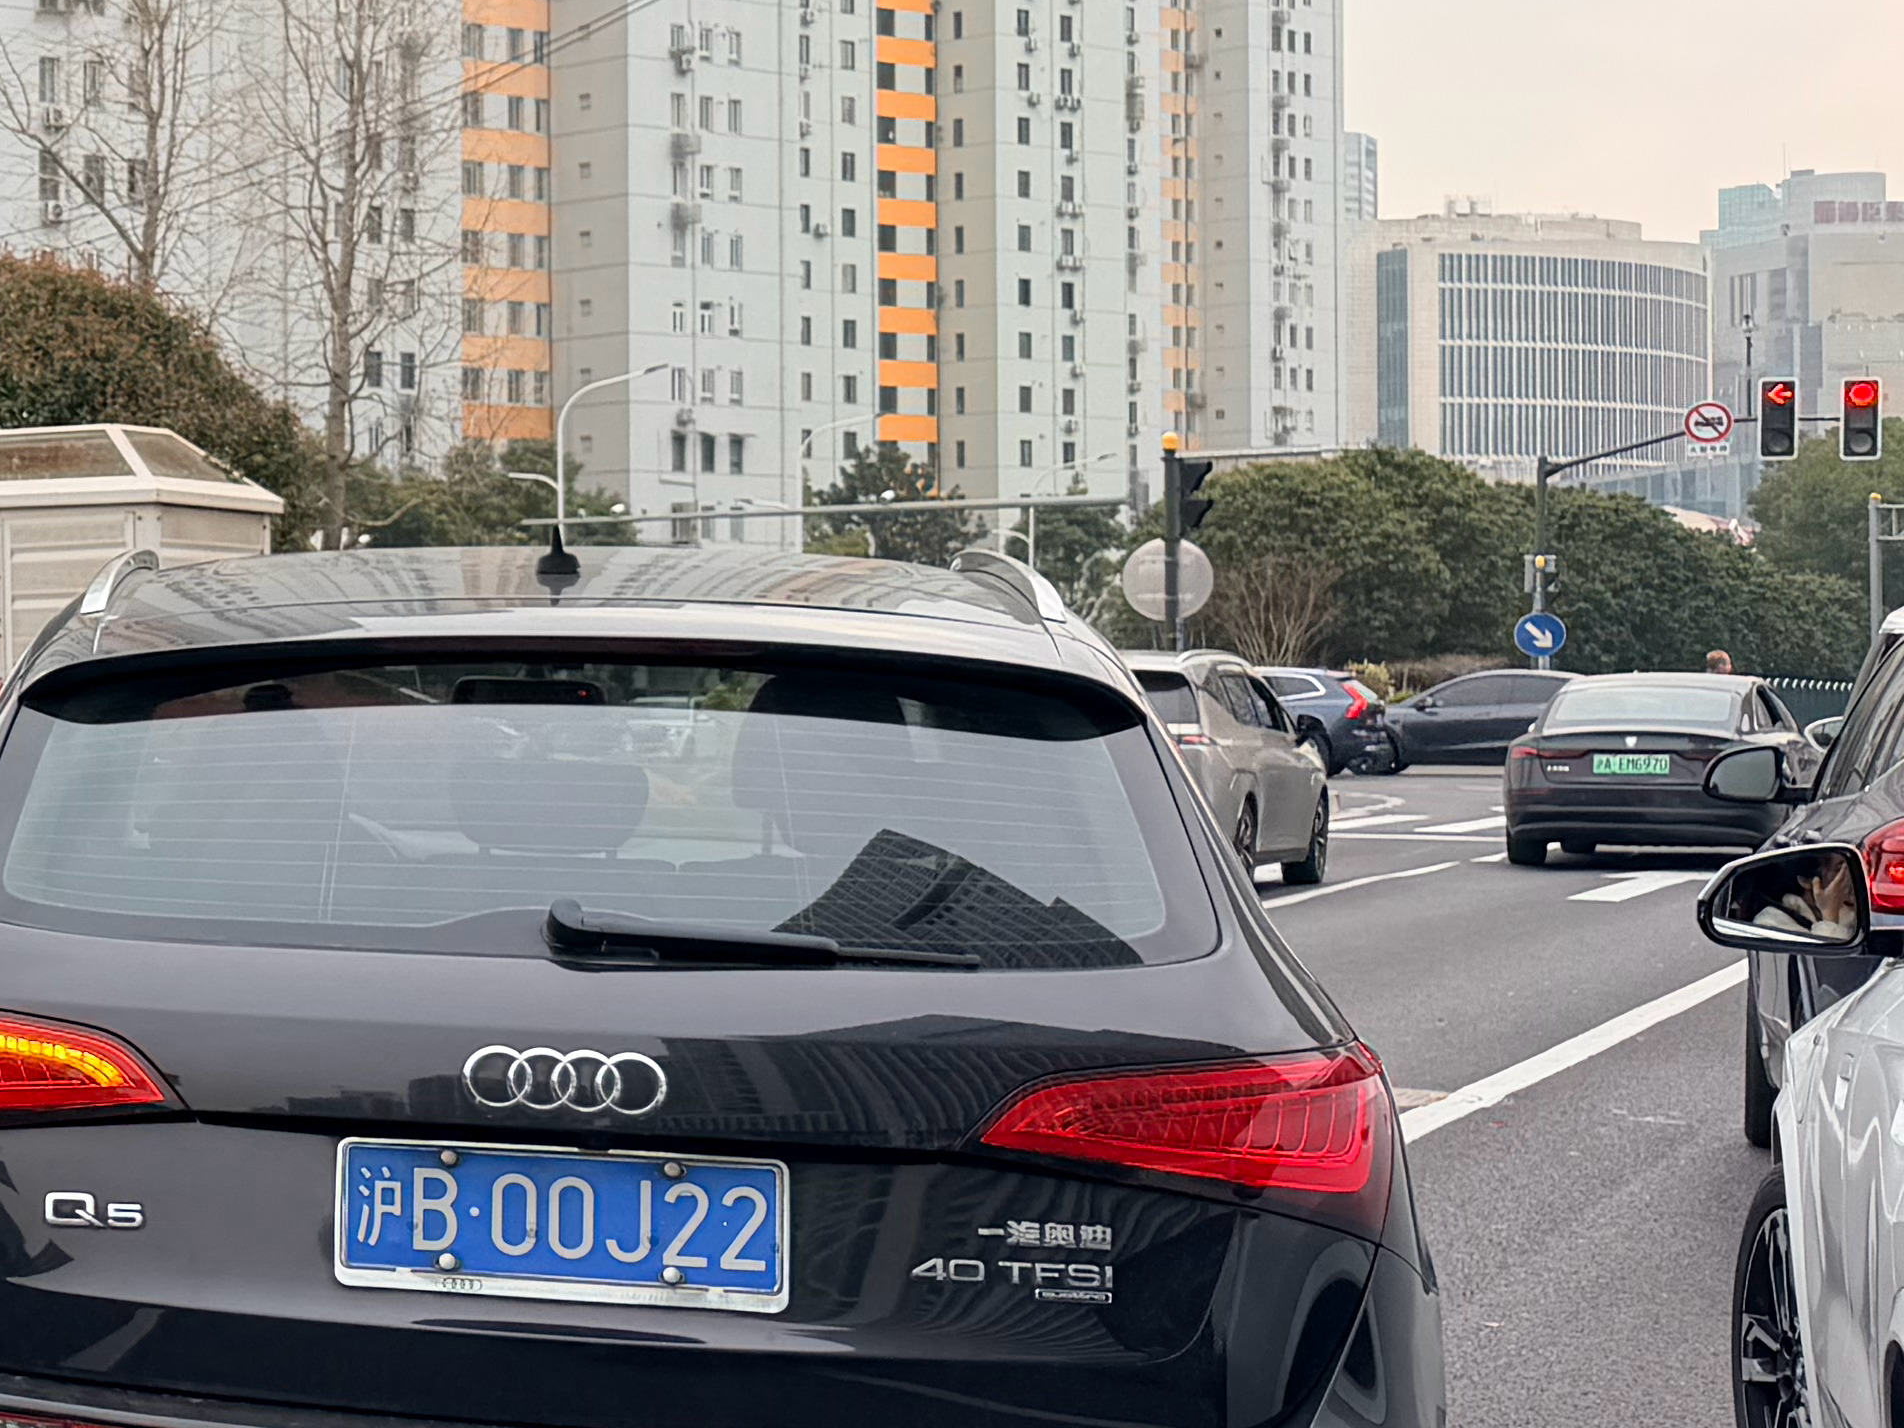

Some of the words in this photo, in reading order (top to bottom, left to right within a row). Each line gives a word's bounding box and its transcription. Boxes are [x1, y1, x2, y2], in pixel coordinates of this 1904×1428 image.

[45, 1192, 143, 1227] Q5
[977, 1220, 1112, 1250] 一汽奥迪
[911, 1258, 986, 1282] 40
[998, 1261, 1114, 1288] TFSI
